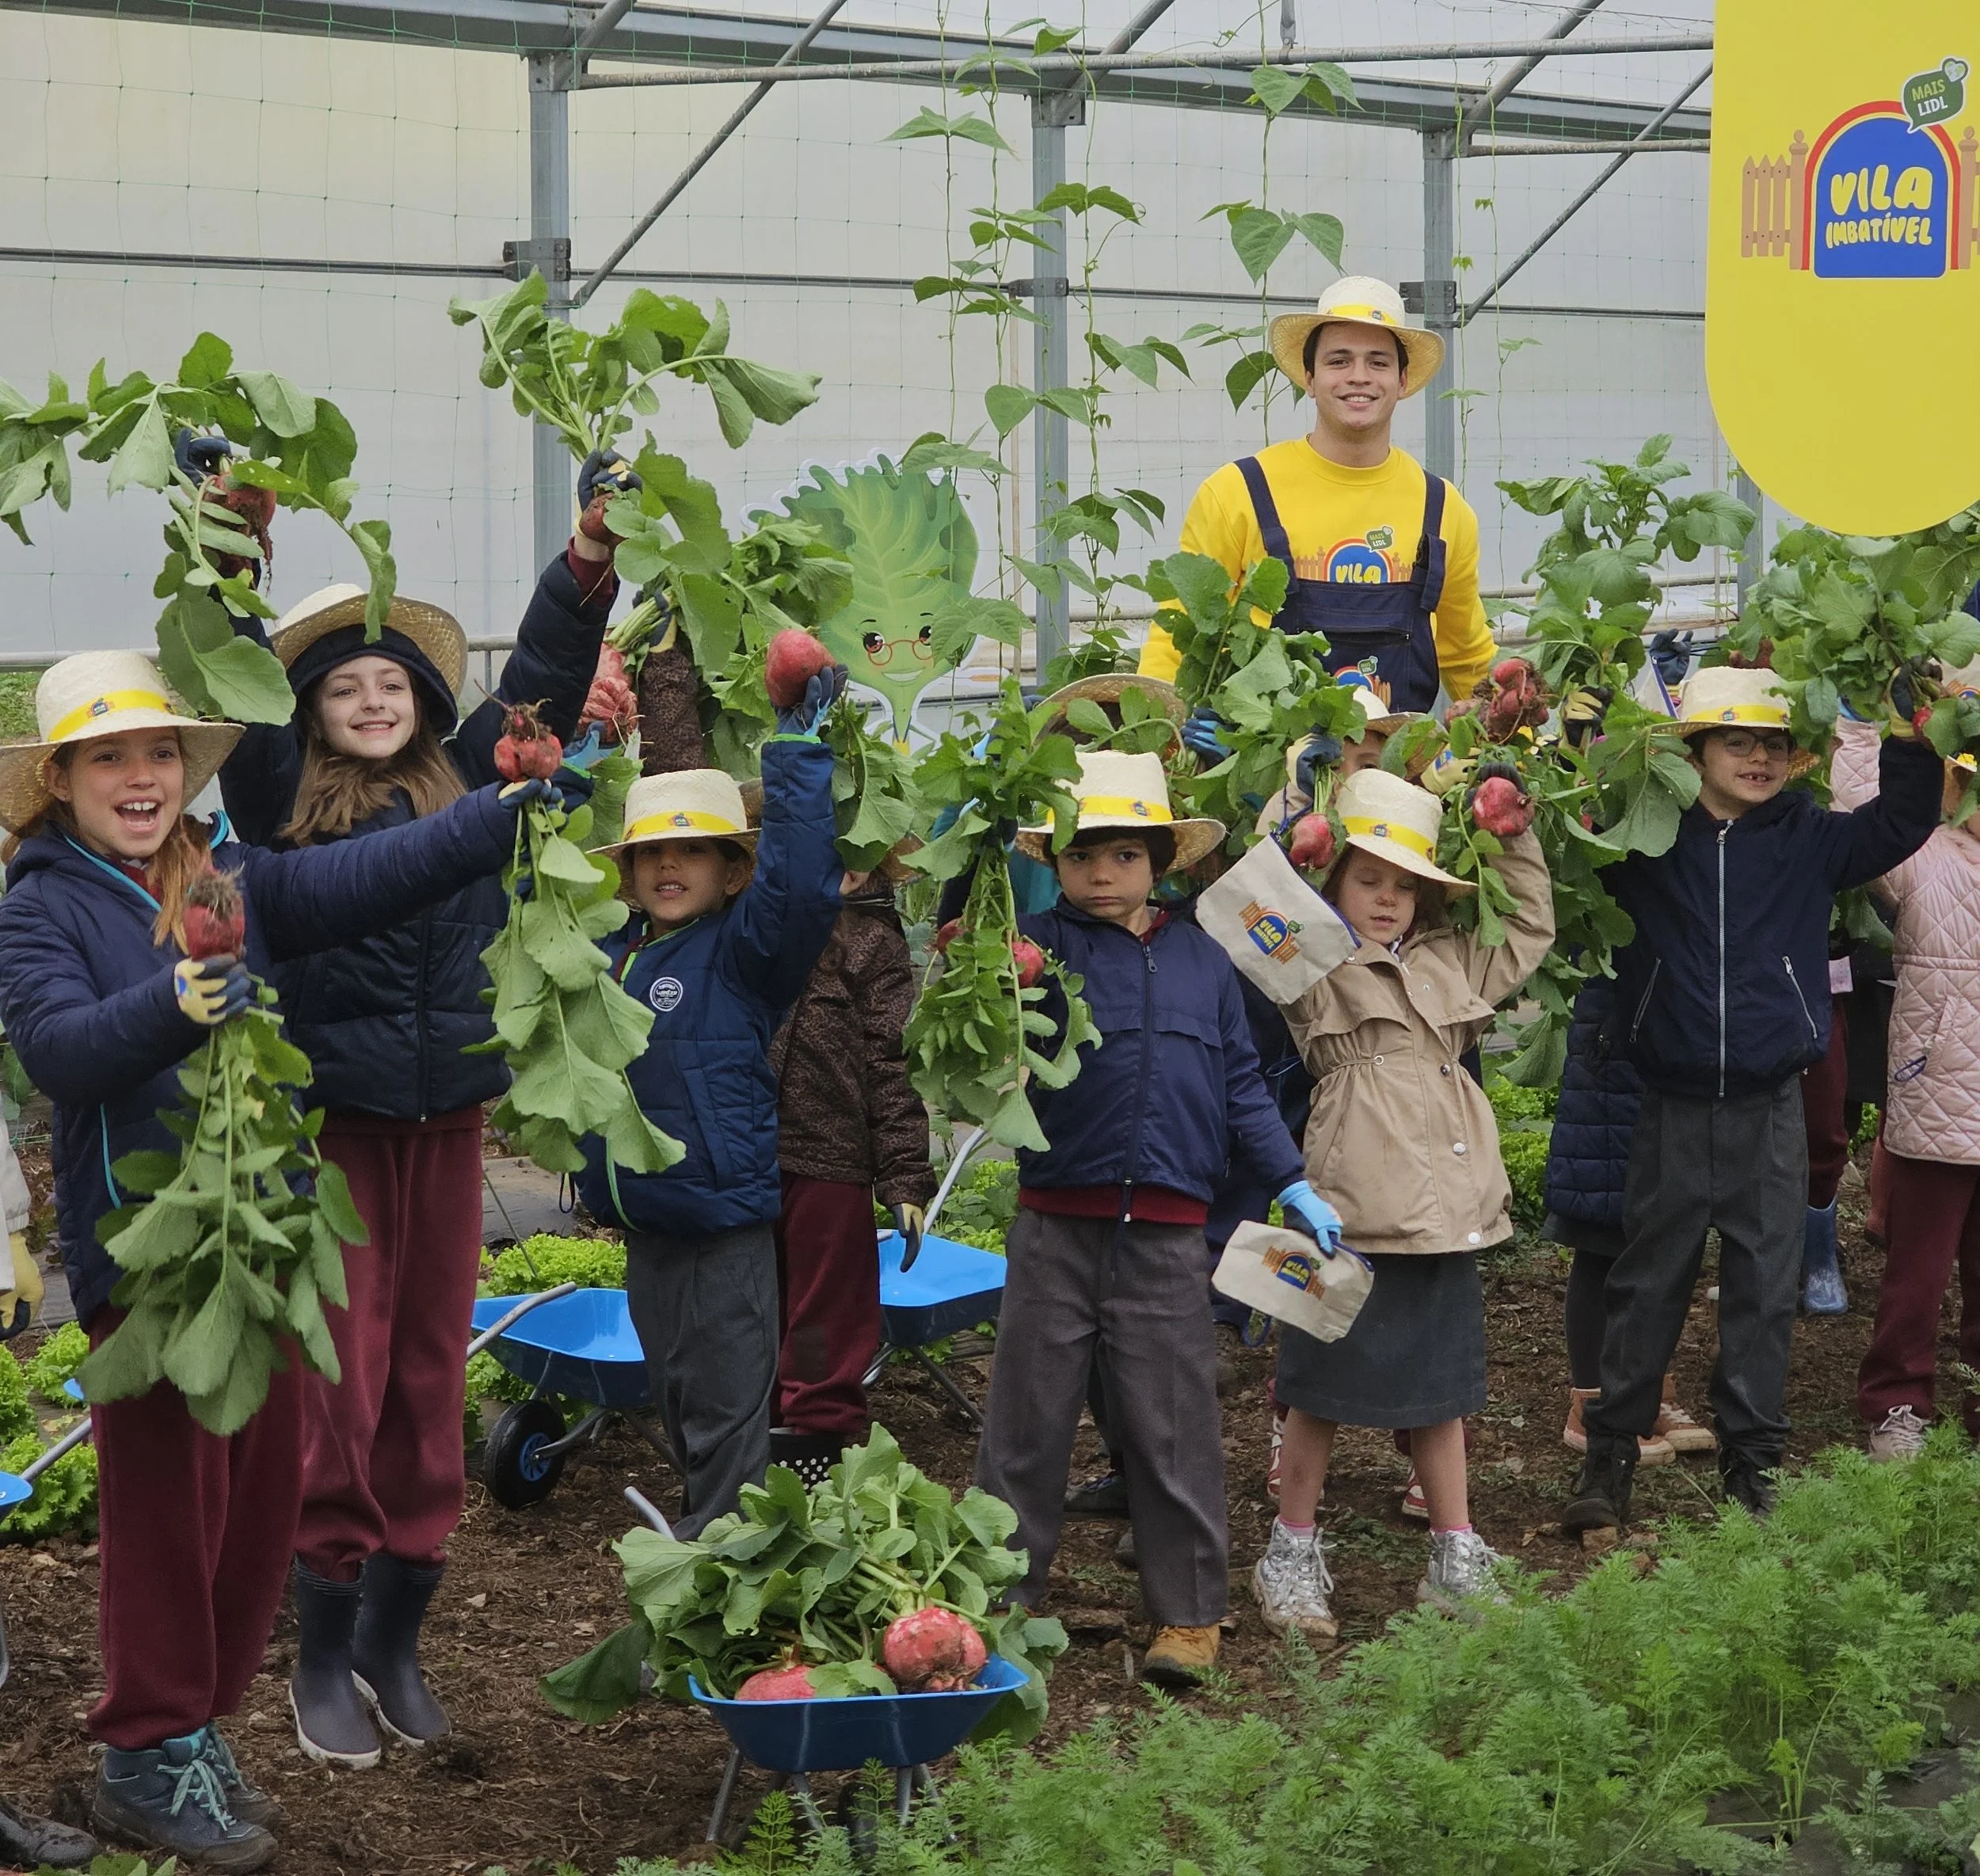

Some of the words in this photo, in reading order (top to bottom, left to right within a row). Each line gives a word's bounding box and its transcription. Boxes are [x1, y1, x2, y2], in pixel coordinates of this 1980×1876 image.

[1911, 79, 1945, 101] MAIS
[1917, 96, 1948, 116] LIDL
[1830, 164, 1933, 215] VILA
[1826, 211, 1932, 249] IMBATÍVEL
[1335, 563, 1381, 584] VILA
